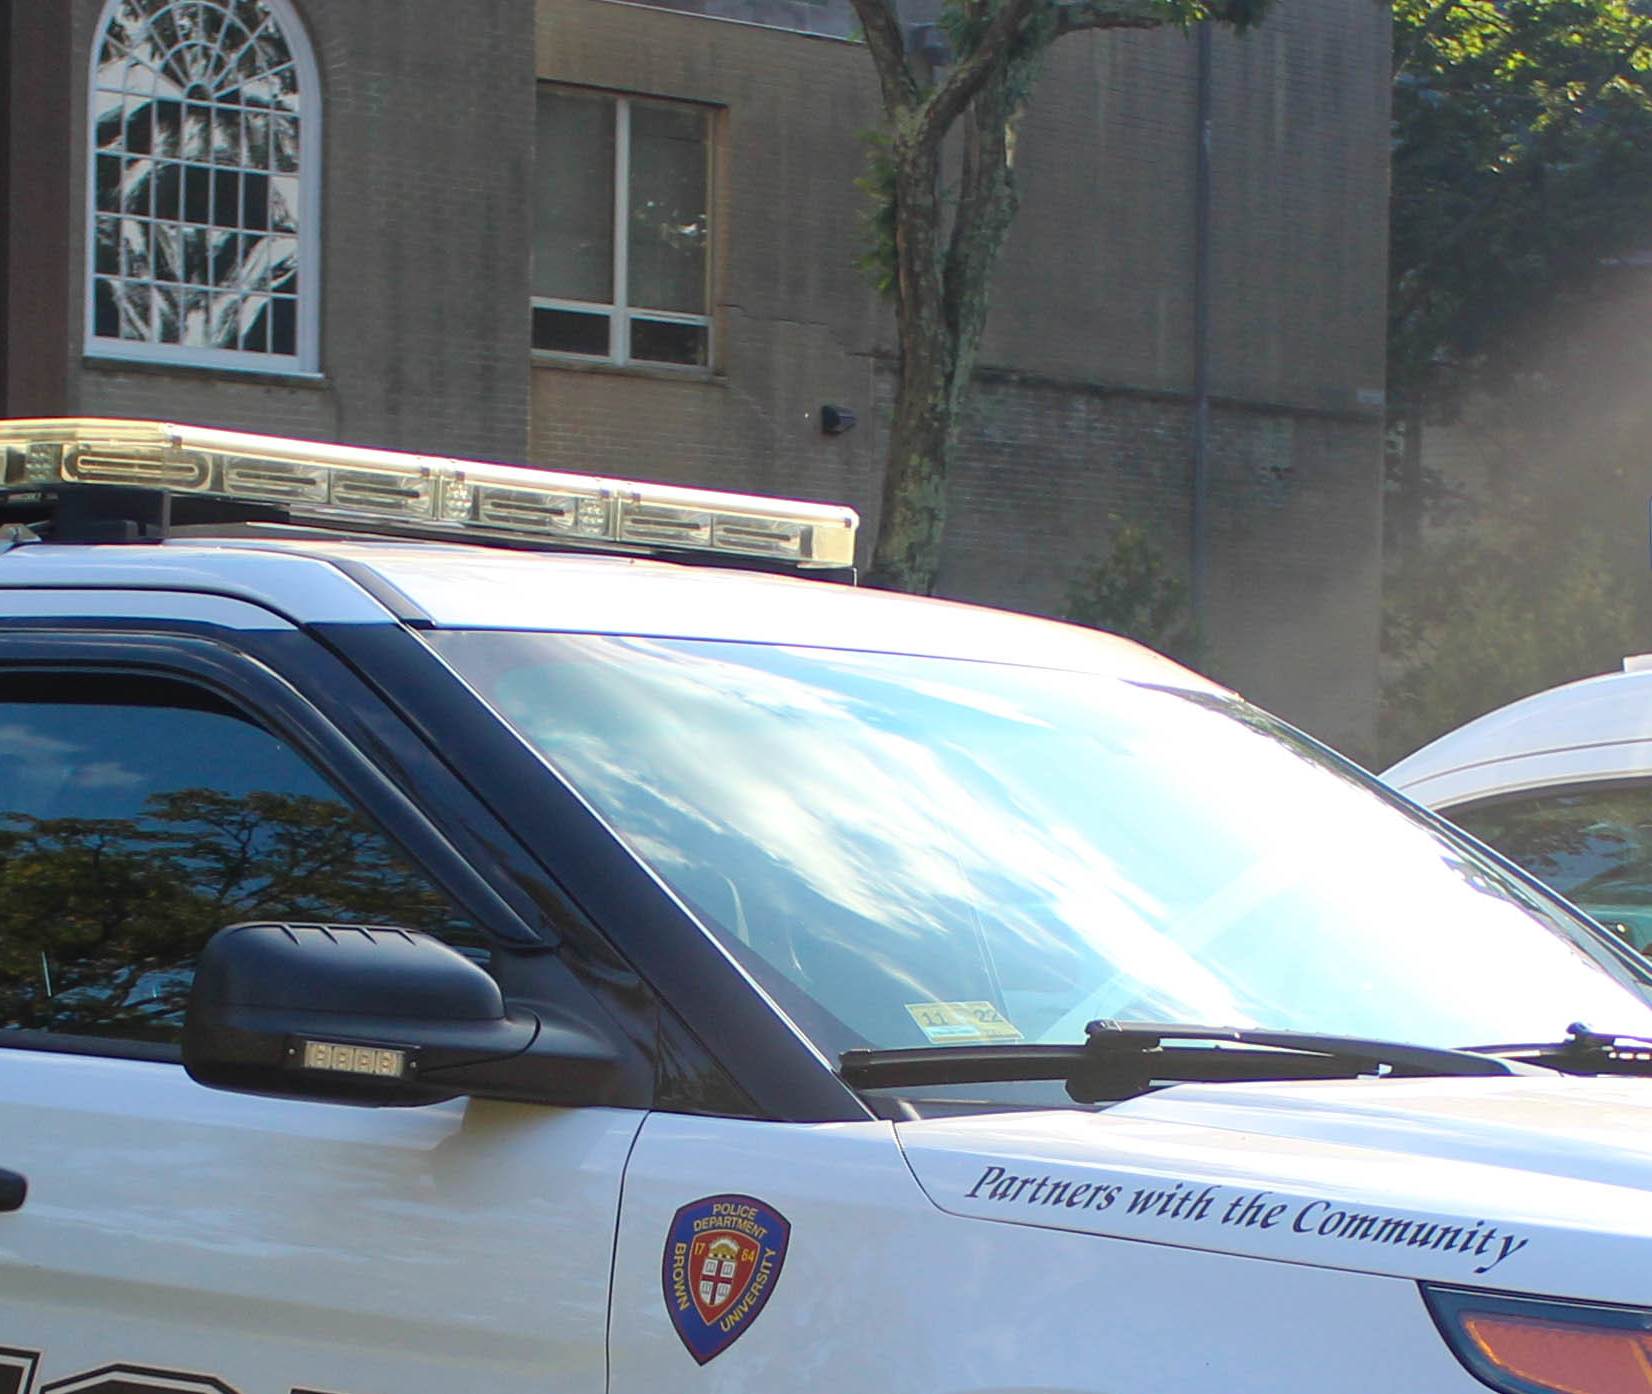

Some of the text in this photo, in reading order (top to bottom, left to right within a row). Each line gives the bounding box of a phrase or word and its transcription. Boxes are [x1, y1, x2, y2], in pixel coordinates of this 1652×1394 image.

[973, 1009, 1005, 1022] 22
[712, 1203, 759, 1221] POLICE
[965, 1166, 1528, 1275] Partners with the Community
[693, 1216, 768, 1239] DEPARTMENT
[672, 1242, 777, 1332] BROWN UNIVERSITY
